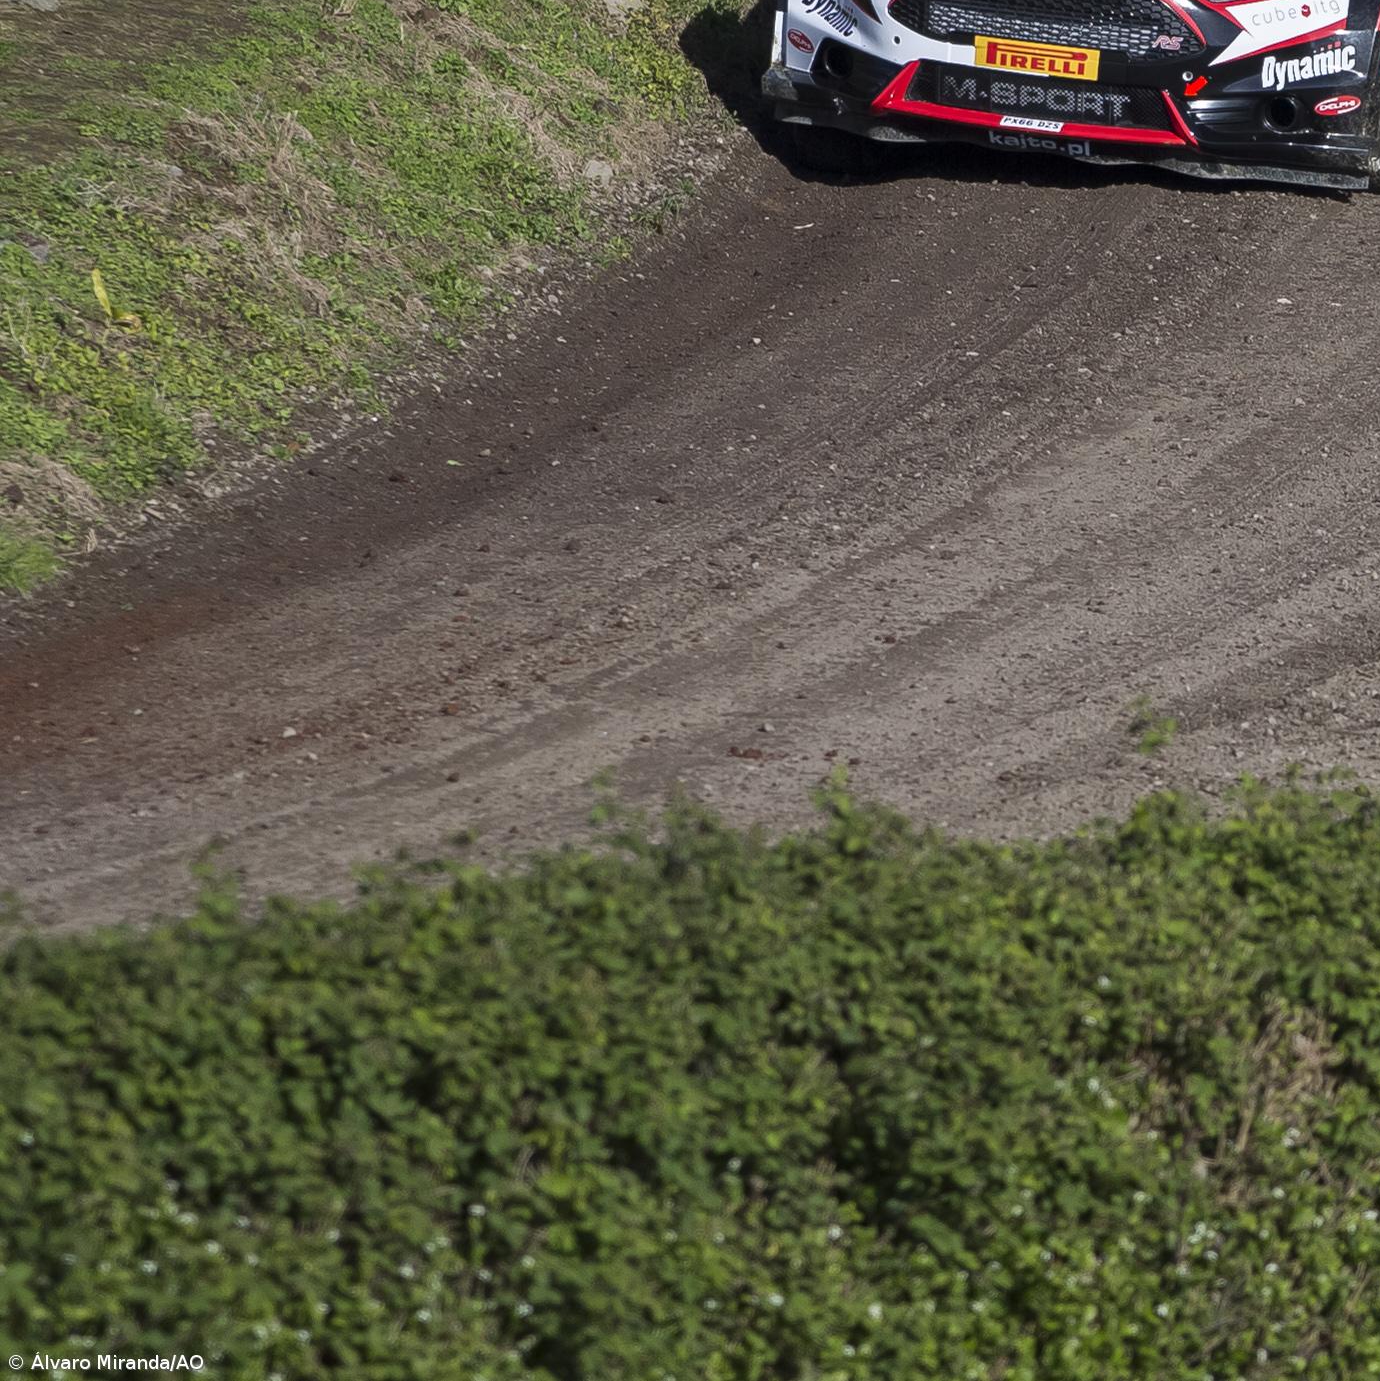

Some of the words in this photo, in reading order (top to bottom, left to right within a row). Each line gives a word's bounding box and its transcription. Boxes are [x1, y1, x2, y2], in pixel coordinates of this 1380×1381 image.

[1252, 7, 1298, 27] cube
[986, 41, 1088, 76] PIRELLI
[1262, 43, 1356, 91] Dynamic
[988, 130, 1090, 157] kajto.pl
